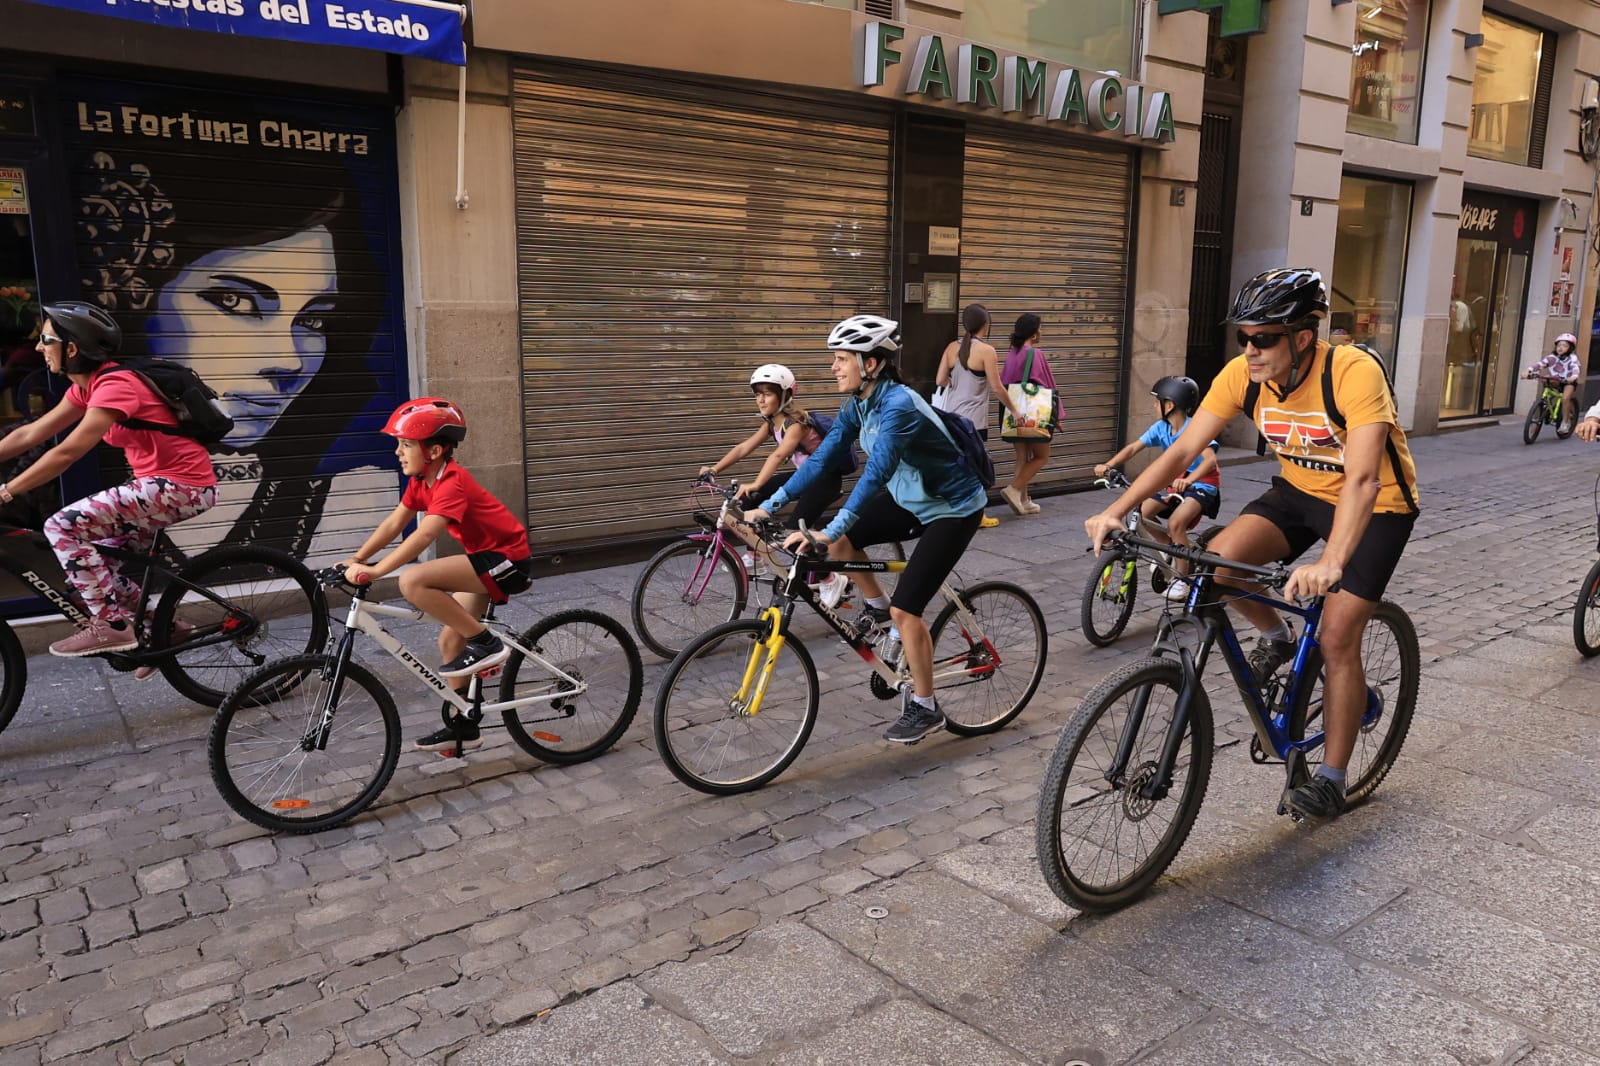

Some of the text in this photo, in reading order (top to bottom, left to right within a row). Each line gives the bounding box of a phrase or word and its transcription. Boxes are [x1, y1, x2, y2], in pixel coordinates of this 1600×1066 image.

[259, 0, 310, 25] del
[325, 4, 430, 41] Estado
[863, 21, 1176, 143] FARMACIA
[78, 101, 368, 155] La Fortuna Charra
